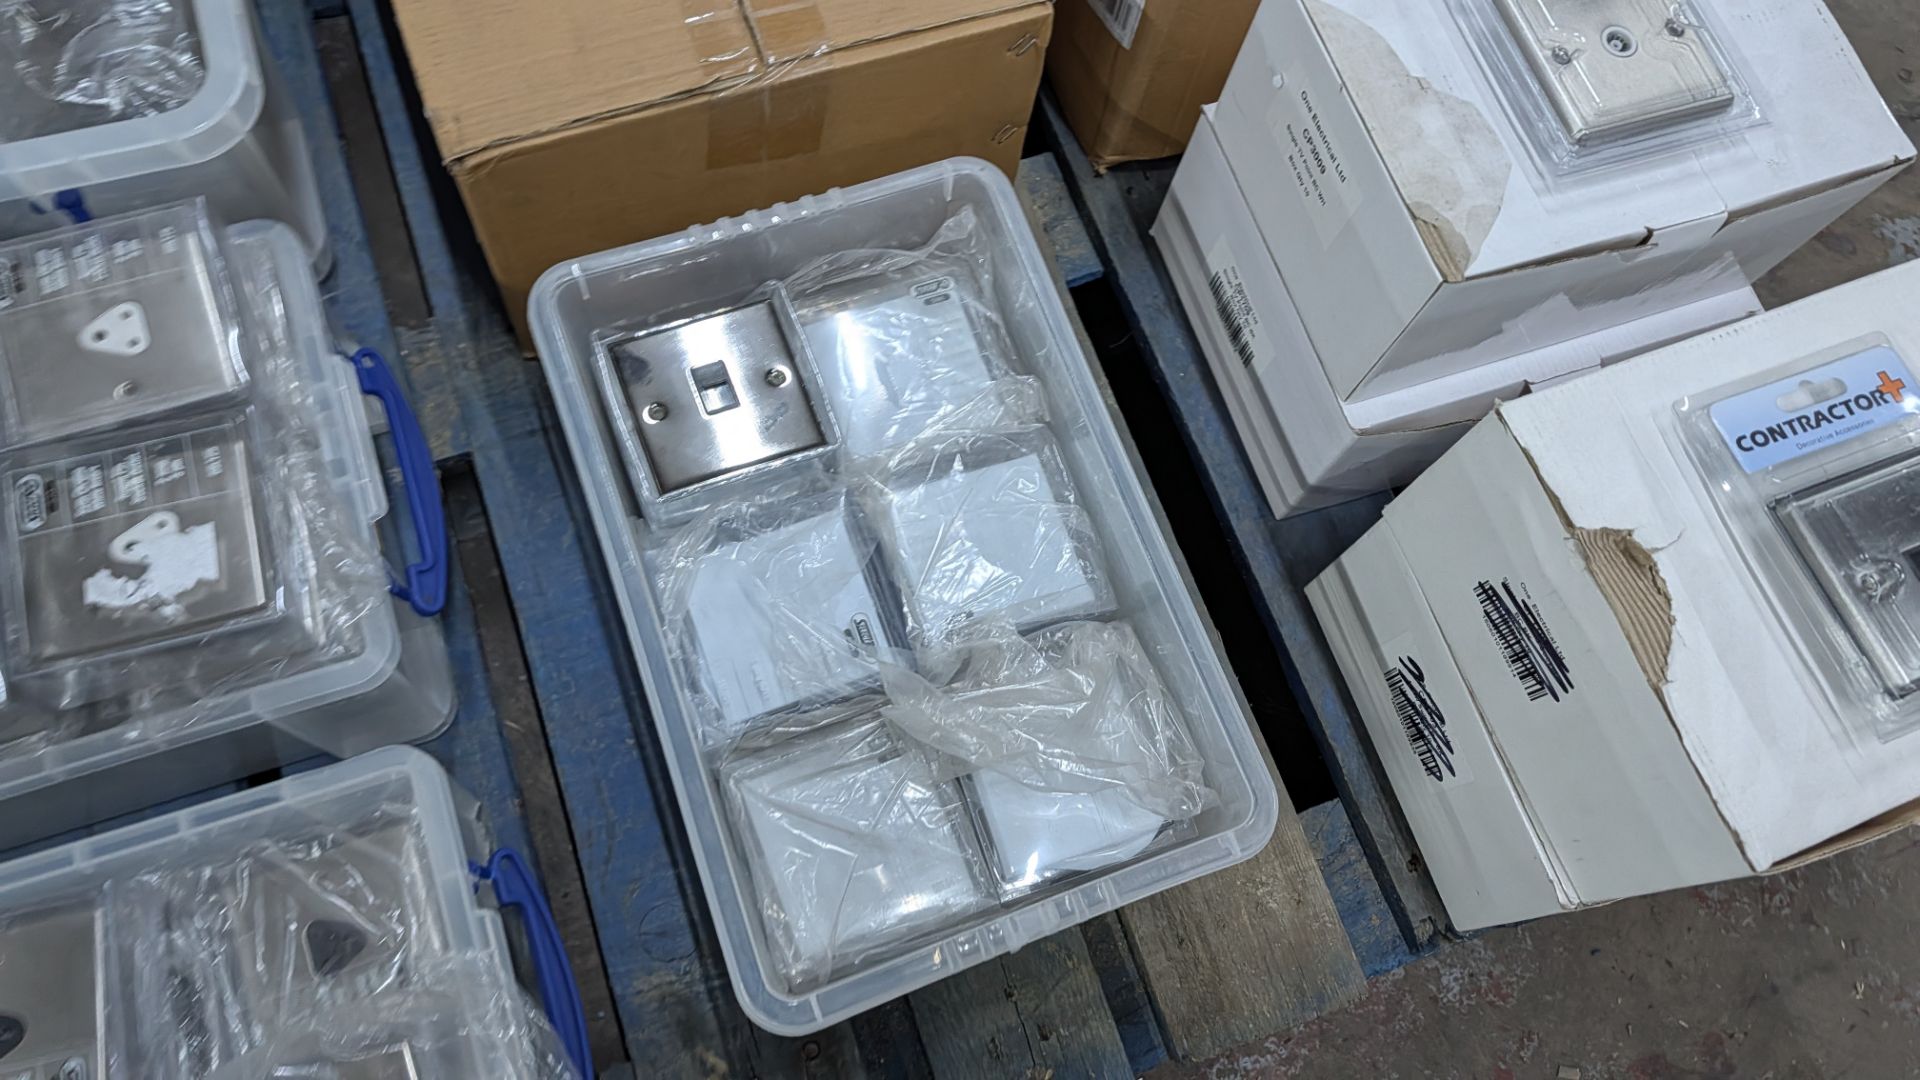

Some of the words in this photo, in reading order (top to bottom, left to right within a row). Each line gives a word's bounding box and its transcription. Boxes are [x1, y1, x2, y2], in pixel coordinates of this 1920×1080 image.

[1301, 90, 1312, 113] One
[1312, 113, 1337, 163] Electrical
[1335, 163, 1346, 183] Ltd
[1796, 431, 1834, 450] Decorative
[1834, 418, 1875, 437] Accessories
[1520, 582, 1531, 600] One
[1531, 603, 1557, 645] Electrical
